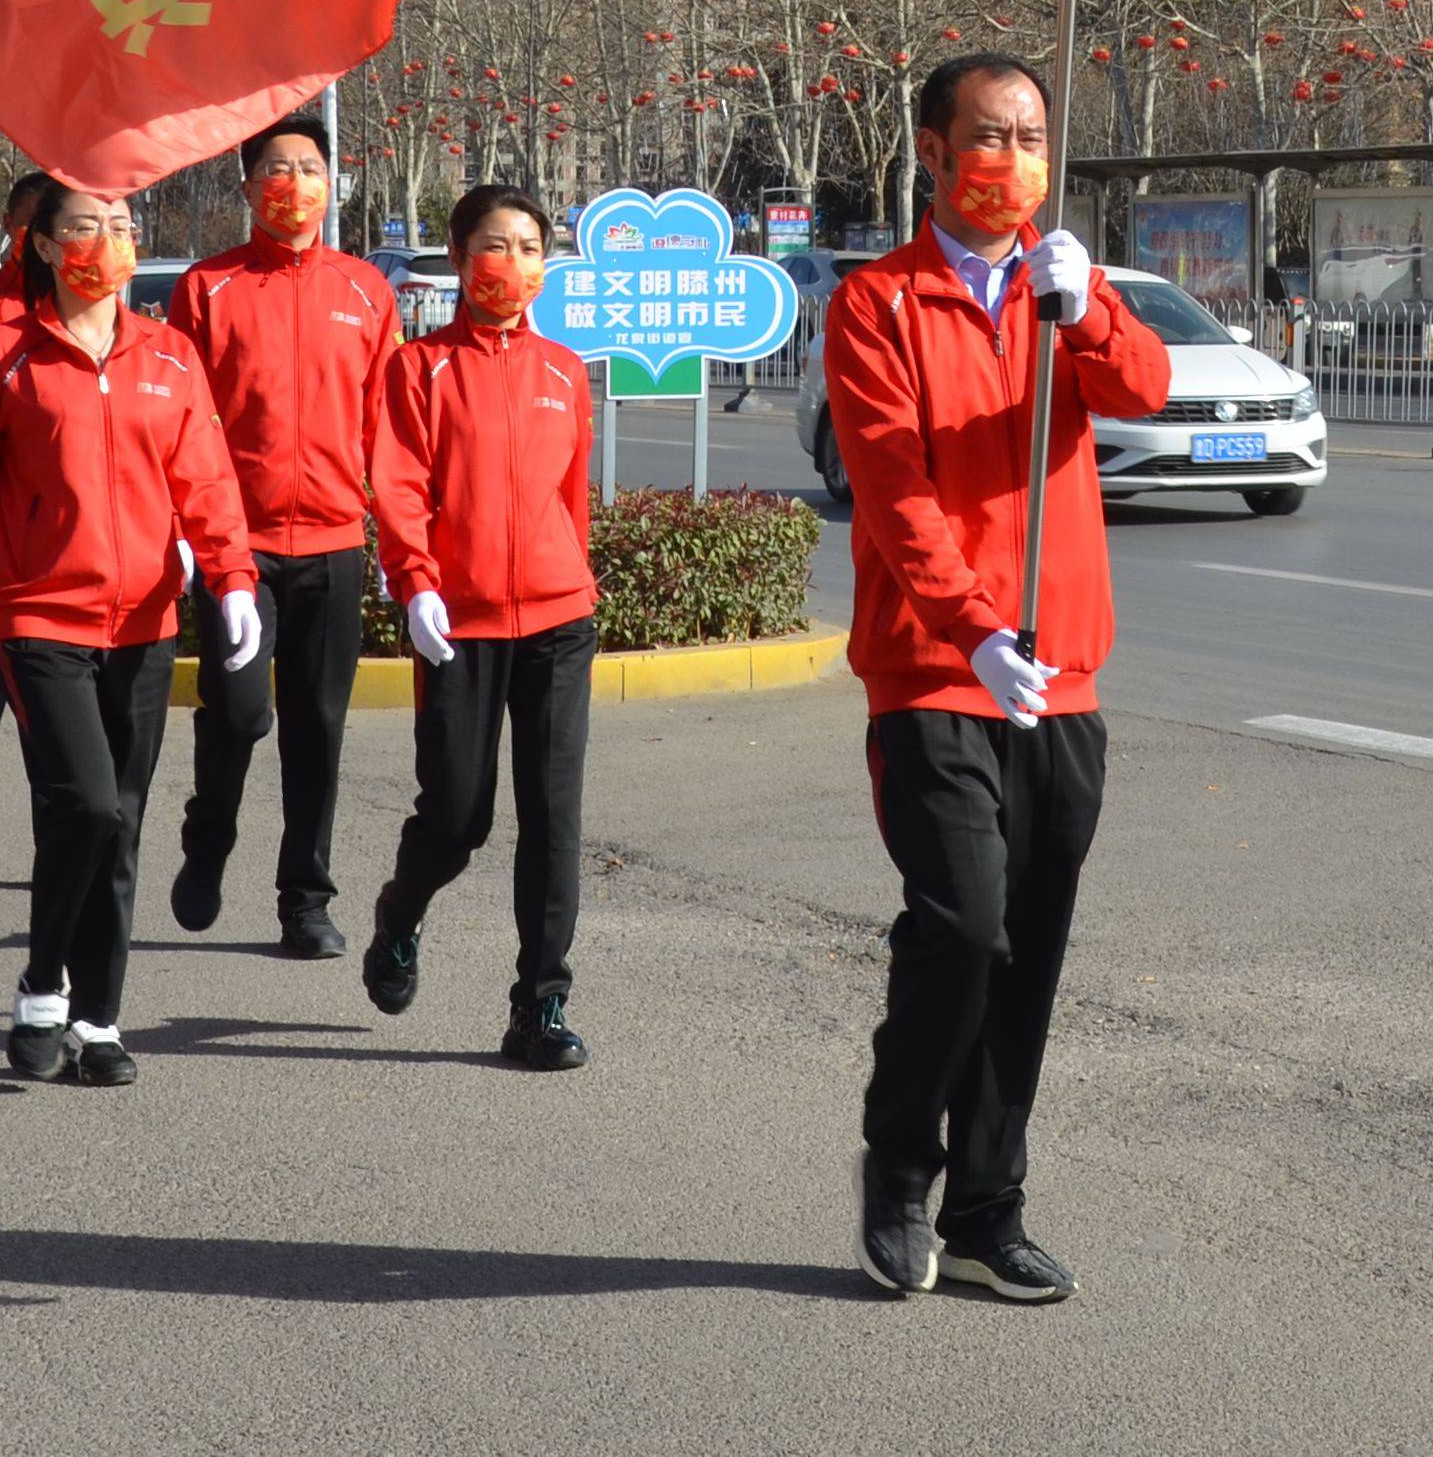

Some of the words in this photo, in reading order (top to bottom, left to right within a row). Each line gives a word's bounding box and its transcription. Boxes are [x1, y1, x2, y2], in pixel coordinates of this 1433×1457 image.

[564, 270, 747, 297] 建文明滕州
[564, 301, 747, 328] 做文明市民
